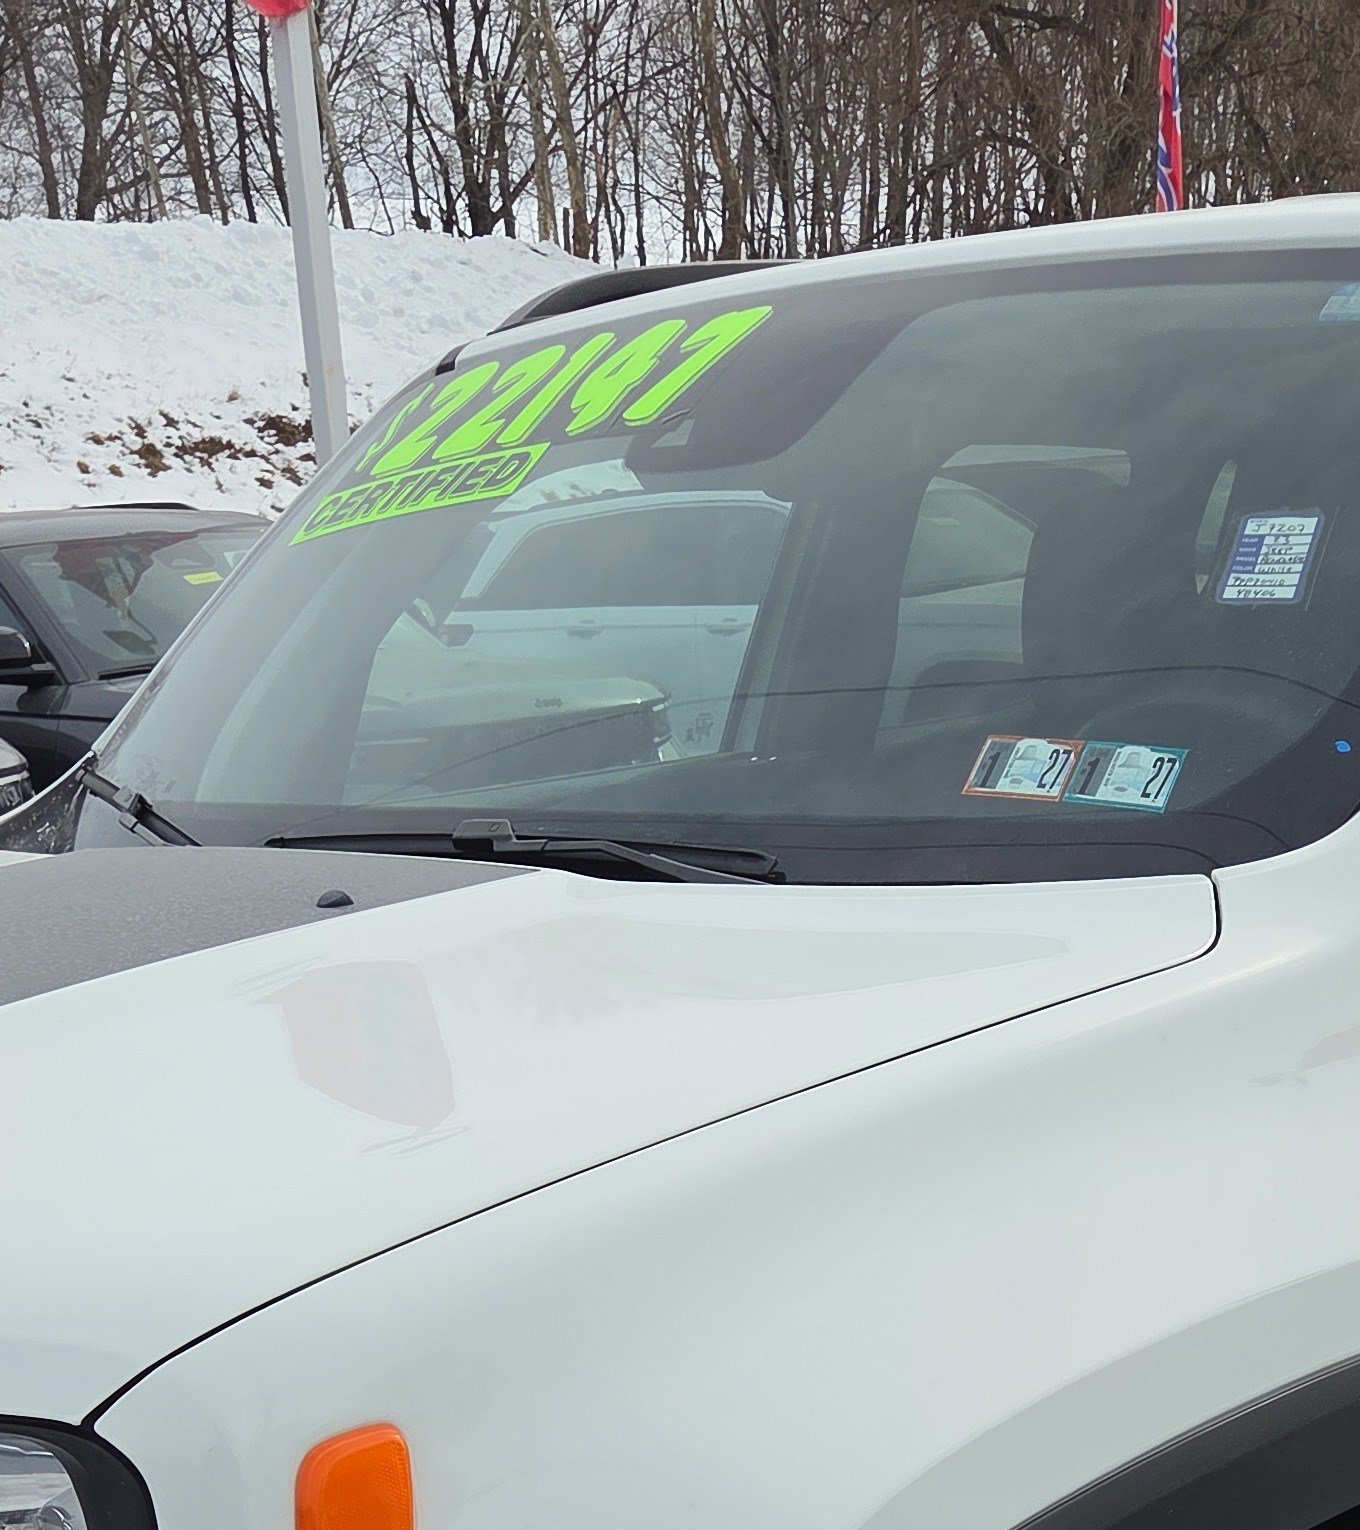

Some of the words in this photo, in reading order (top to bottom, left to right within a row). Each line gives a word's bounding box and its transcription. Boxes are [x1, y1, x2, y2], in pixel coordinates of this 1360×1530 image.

[357, 305, 773, 477] $22147
[304, 450, 534, 535] CERTIFIED
[980, 751, 1002, 789] 1
[1036, 748, 1073, 791] 27
[1079, 757, 1101, 795] 1
[1140, 756, 1178, 800] 27
